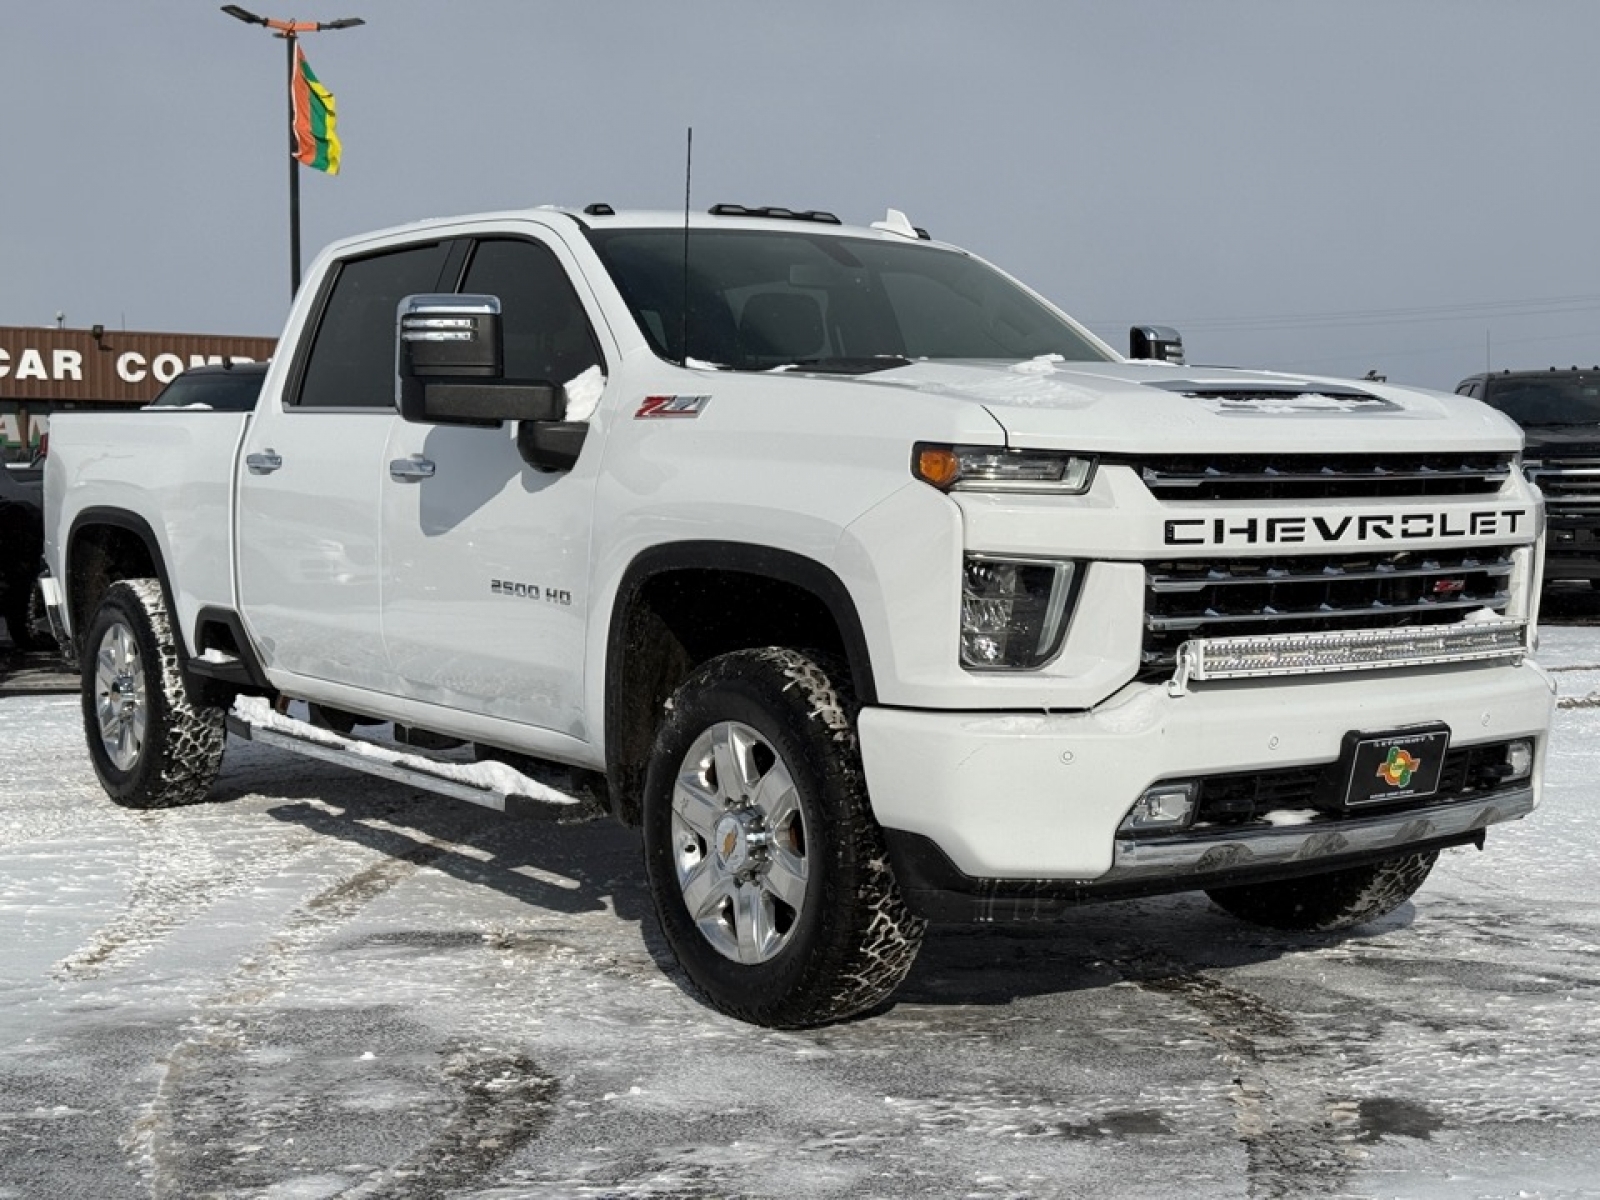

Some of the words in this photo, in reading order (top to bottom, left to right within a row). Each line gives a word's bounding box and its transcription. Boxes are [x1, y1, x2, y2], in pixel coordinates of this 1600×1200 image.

[633, 394, 712, 420] Z71
[1164, 509, 1526, 545] CHEVROLET
[491, 579, 540, 600] 2500
[546, 588, 571, 605] HD
